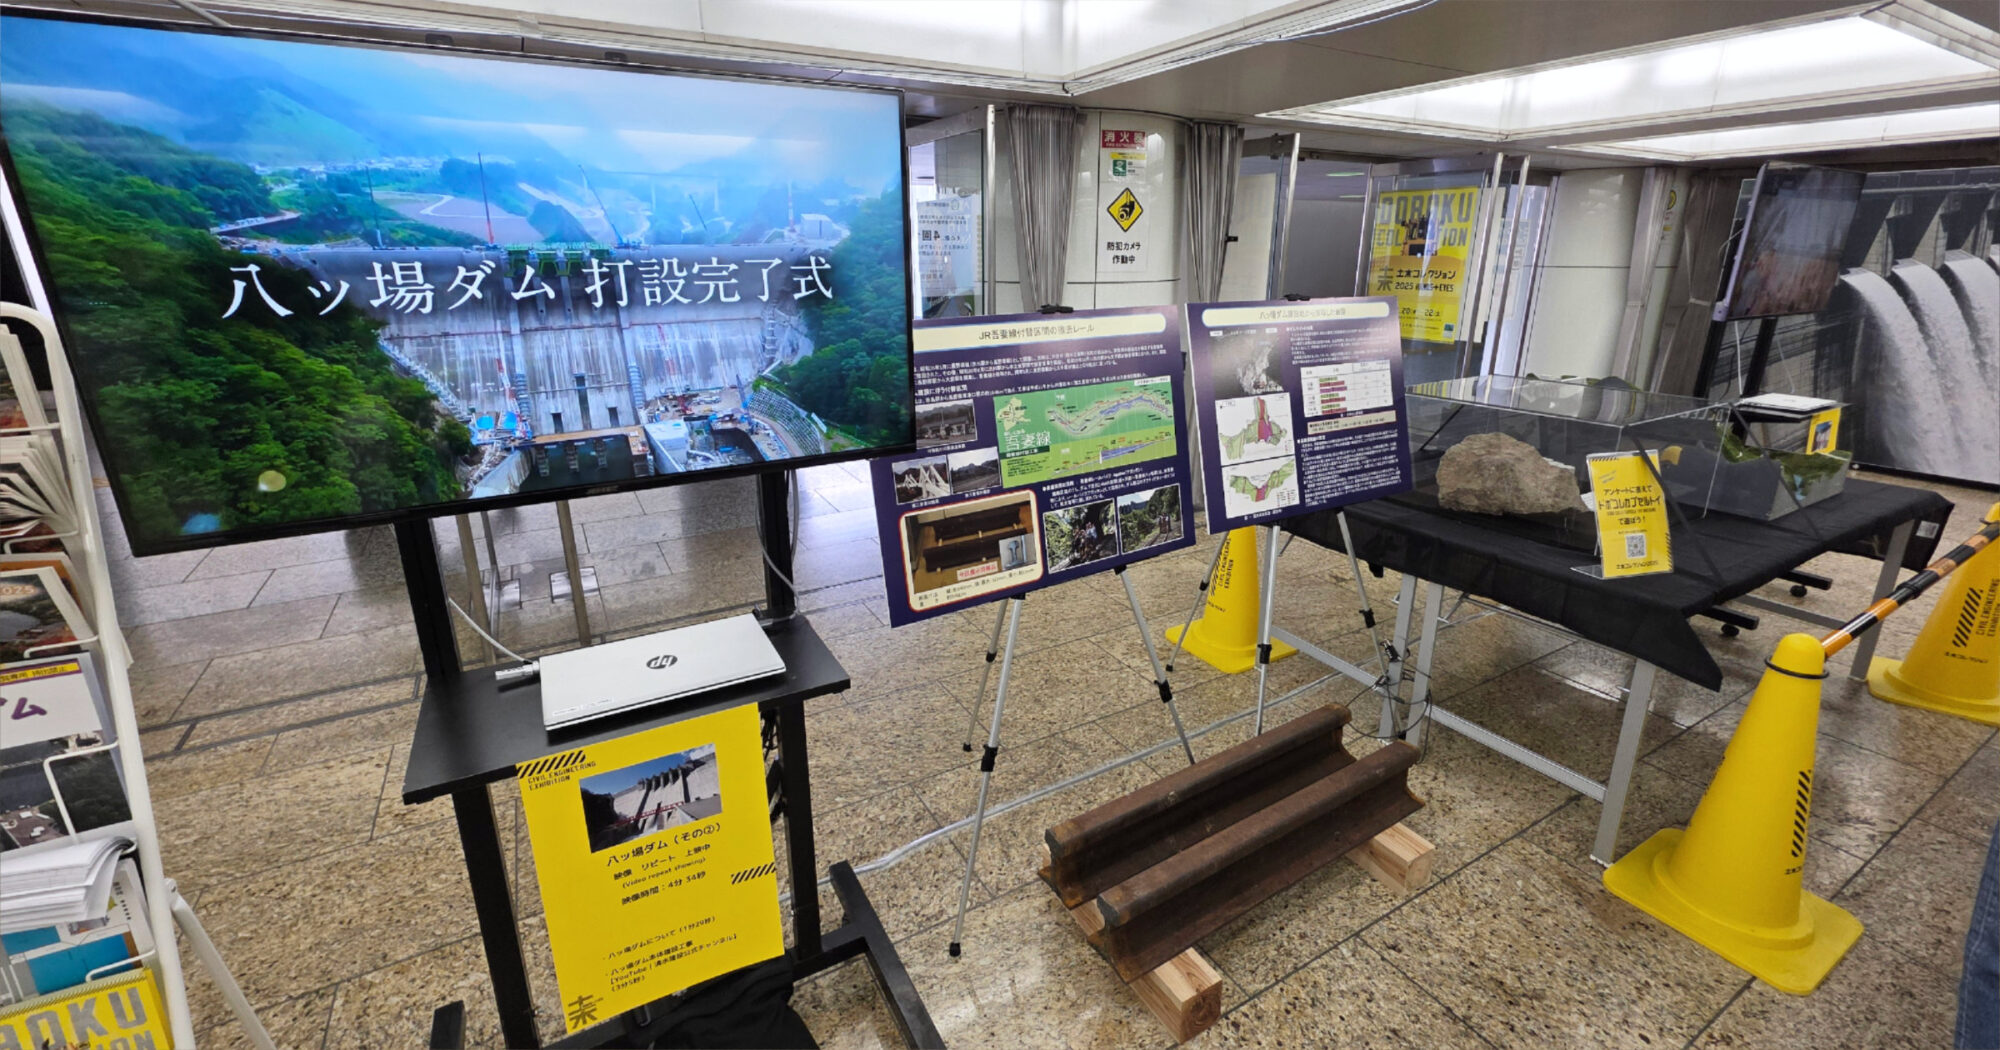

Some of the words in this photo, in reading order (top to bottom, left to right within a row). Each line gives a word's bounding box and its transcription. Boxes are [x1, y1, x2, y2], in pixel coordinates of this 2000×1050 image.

[1107, 241, 1141, 251] 防犯カメラ
[1112, 254, 1136, 264] 作動中
[222, 259, 556, 319] 八ッ場ダム
[582, 256, 833, 309] 打設完了式
[1395, 282, 1414, 290] 2025
[0, 584, 34, 595] 025
[528, 774, 547, 784] CIVIL
[548, 761, 596, 778] ENGINEERING
[529, 774, 570, 791] EXHIBITION
[613, 868, 632, 881] 映像
[641, 855, 676, 870] リピート
[685, 843, 711, 857] 上映中
[648, 868, 672, 880] repeat
[674, 857, 706, 871] showing)
